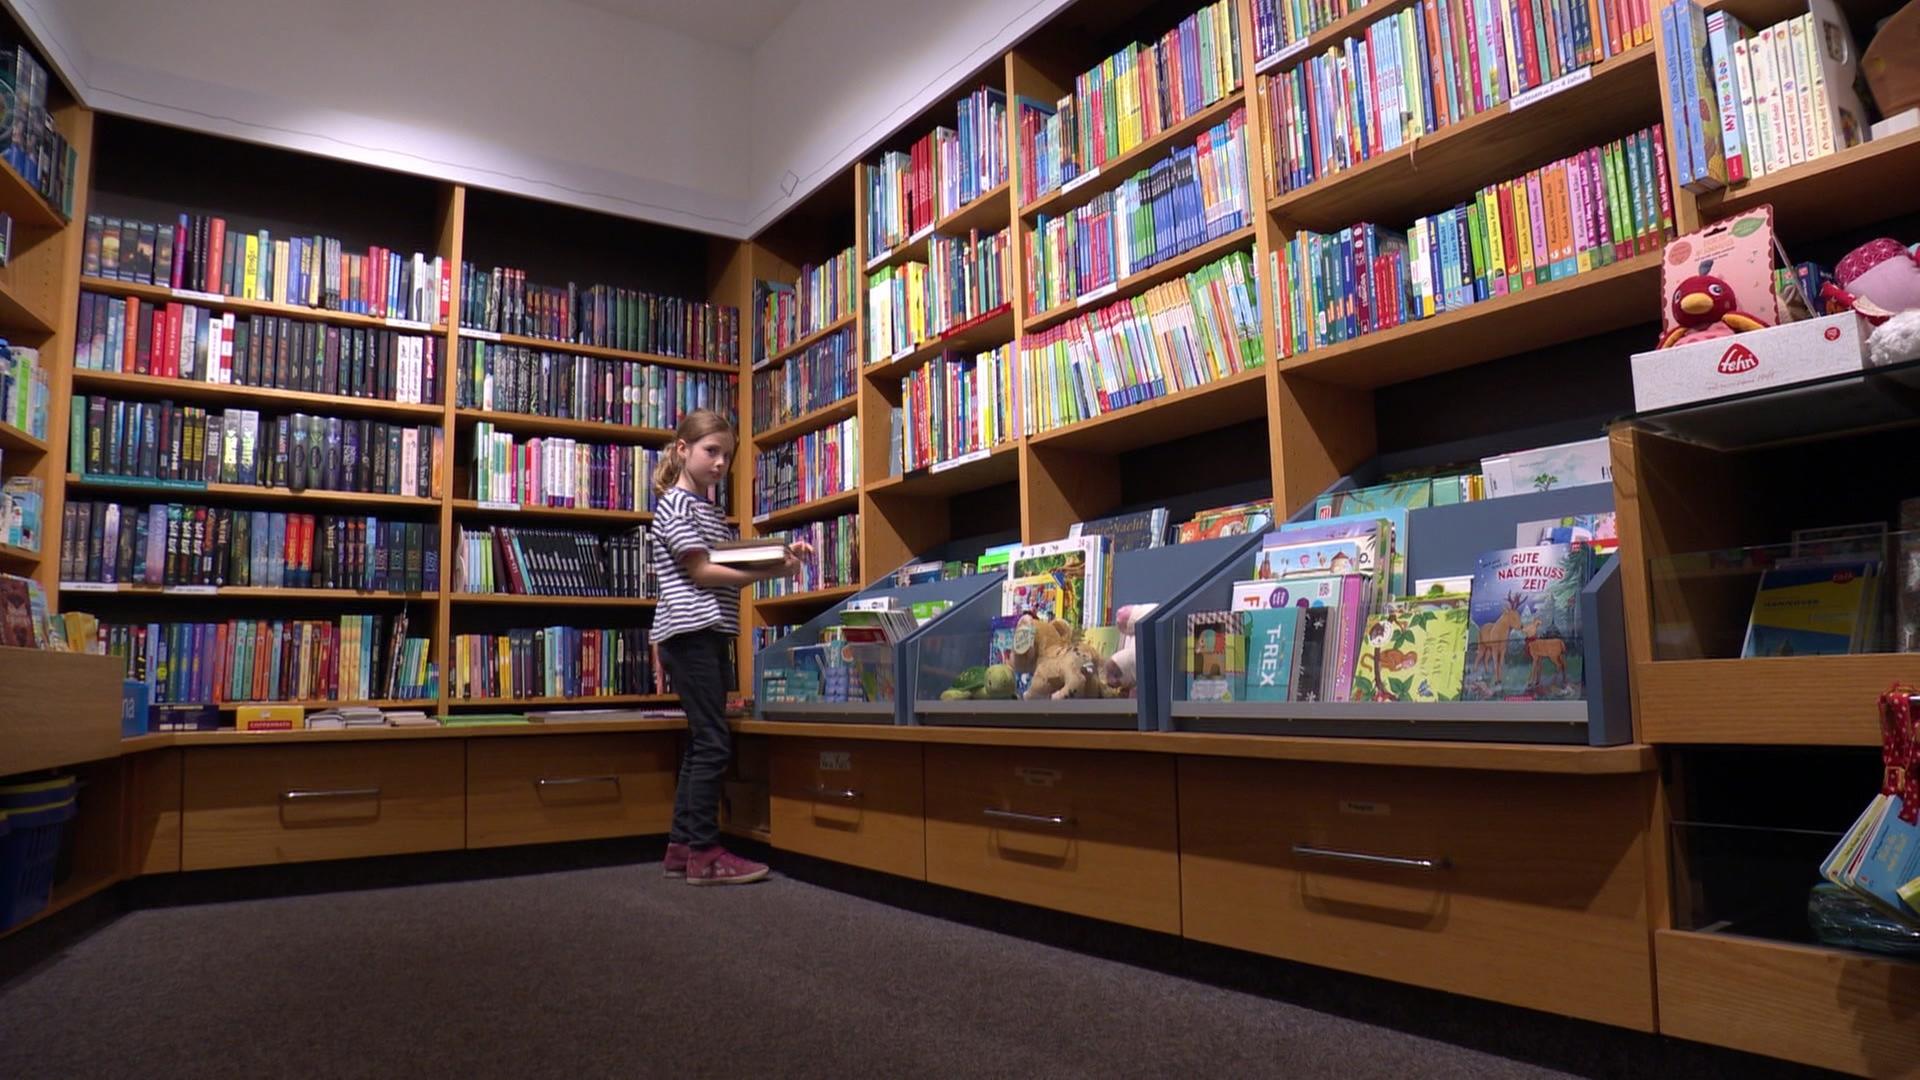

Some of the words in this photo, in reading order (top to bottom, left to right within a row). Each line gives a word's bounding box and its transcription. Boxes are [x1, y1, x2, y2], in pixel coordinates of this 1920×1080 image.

[1720, 349, 1756, 372] fehn
[1511, 552, 1540, 566] GUTE
[1498, 566, 1566, 581] NACHTKUSS
[1522, 578, 1547, 591] ZEIT
[1260, 623, 1282, 687] T-REX
